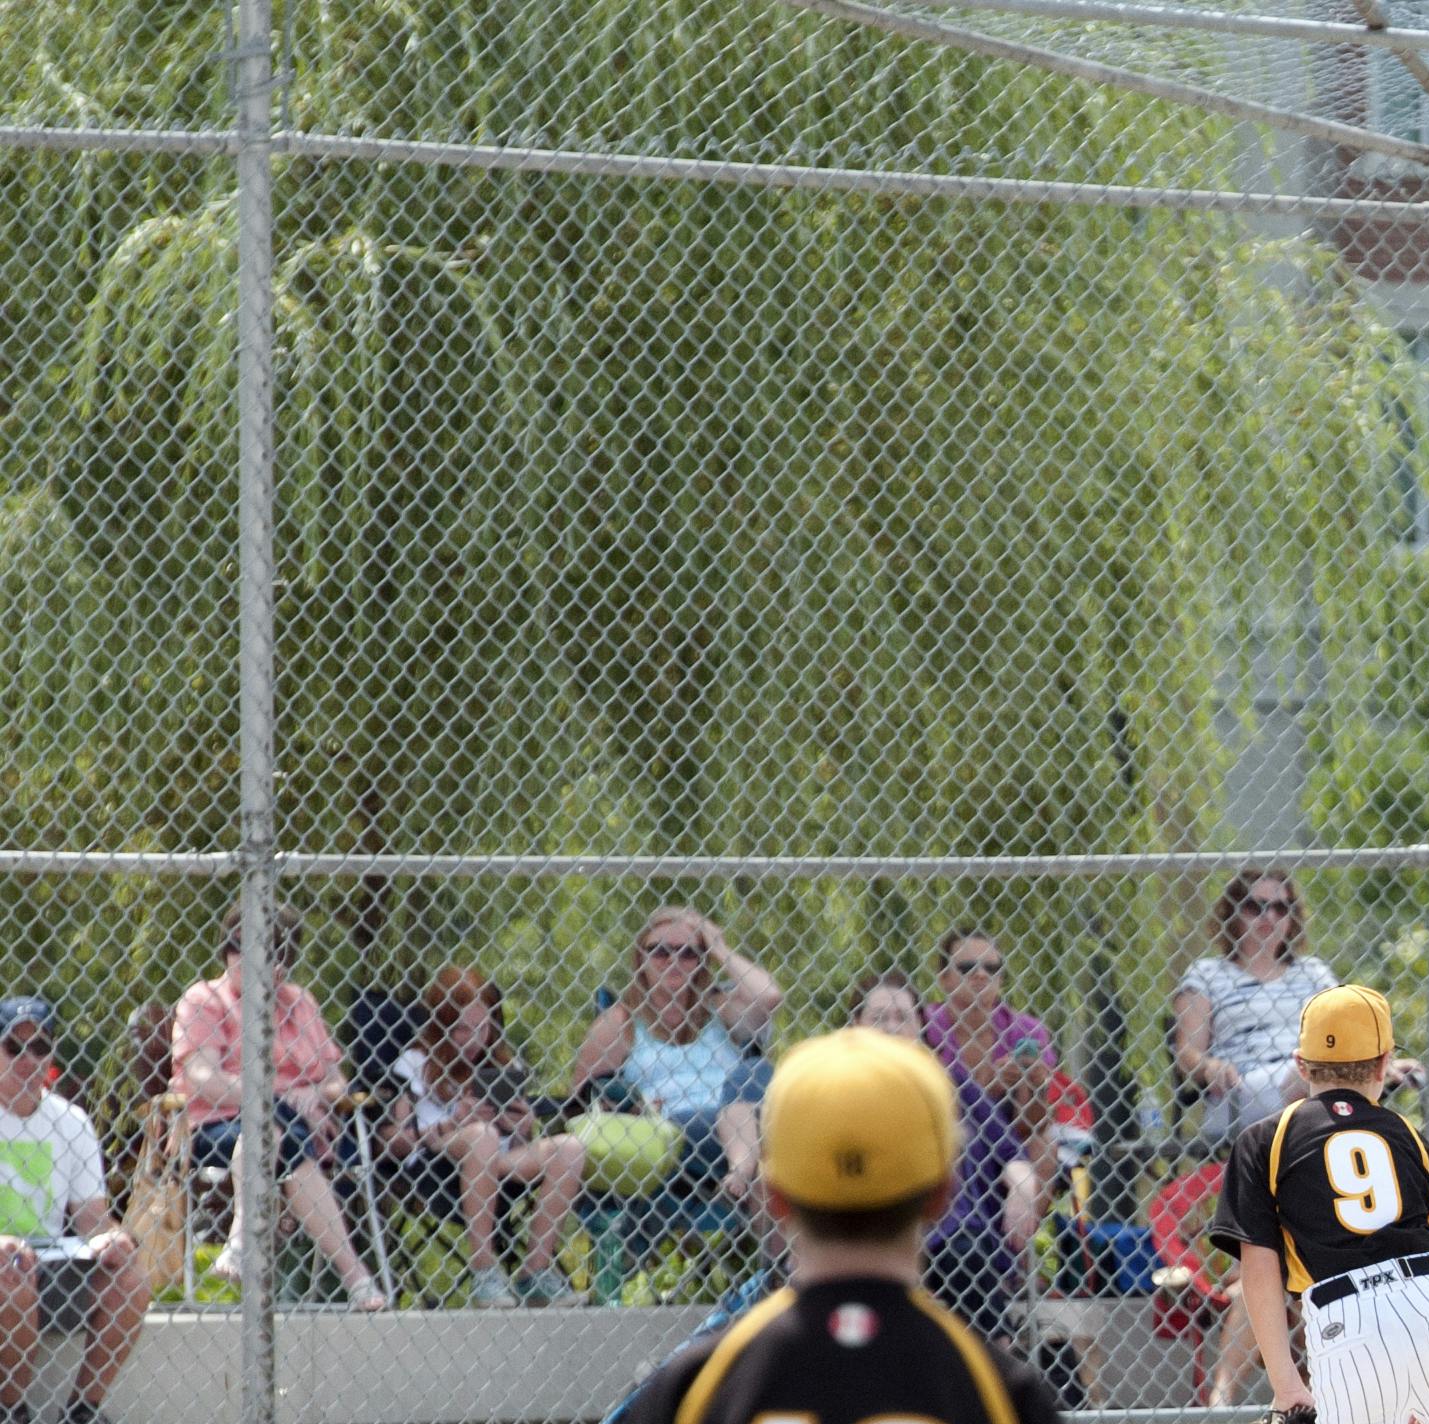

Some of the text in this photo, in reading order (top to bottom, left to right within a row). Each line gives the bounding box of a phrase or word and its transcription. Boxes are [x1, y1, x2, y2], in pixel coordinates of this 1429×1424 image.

[1325, 1034, 1336, 1049] 9
[1323, 1129, 1404, 1236] 9
[1360, 1269, 1398, 1292] TPX
